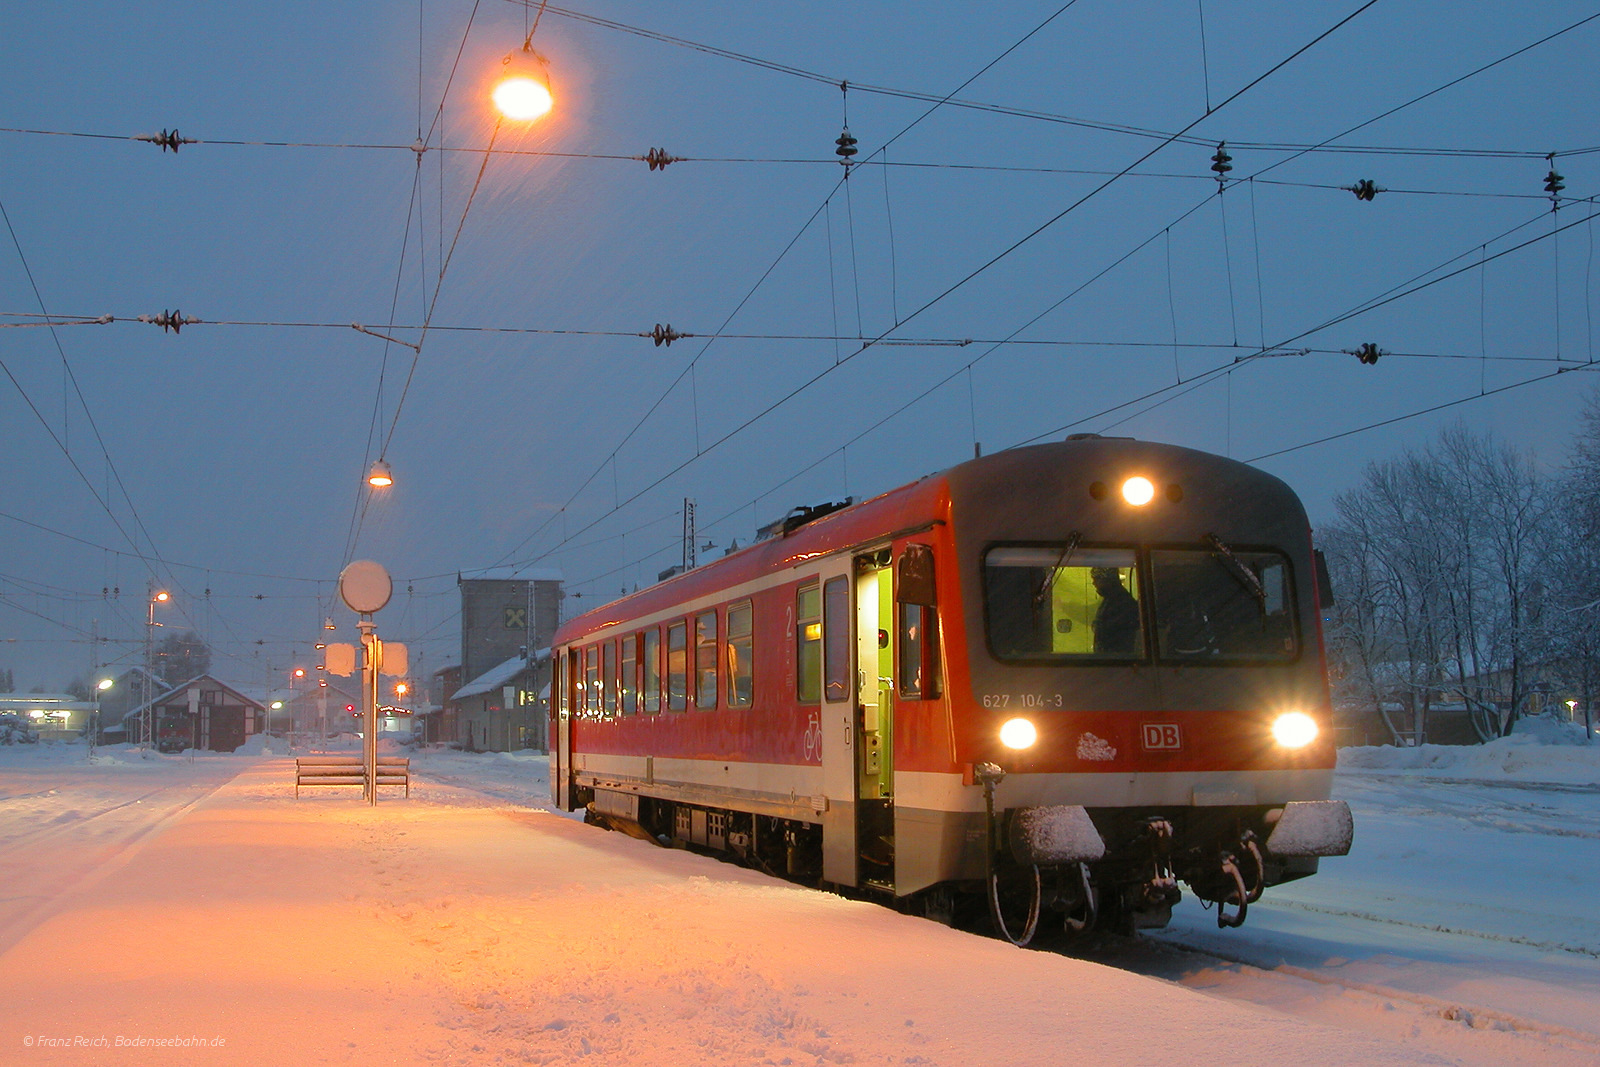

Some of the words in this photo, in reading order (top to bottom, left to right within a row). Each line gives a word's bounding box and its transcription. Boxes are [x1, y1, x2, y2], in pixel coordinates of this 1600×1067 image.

[786, 606, 793, 637] 2
[983, 695, 1010, 708] 627
[1021, 694, 1063, 708] 104-3
[1145, 725, 1179, 748] DB
